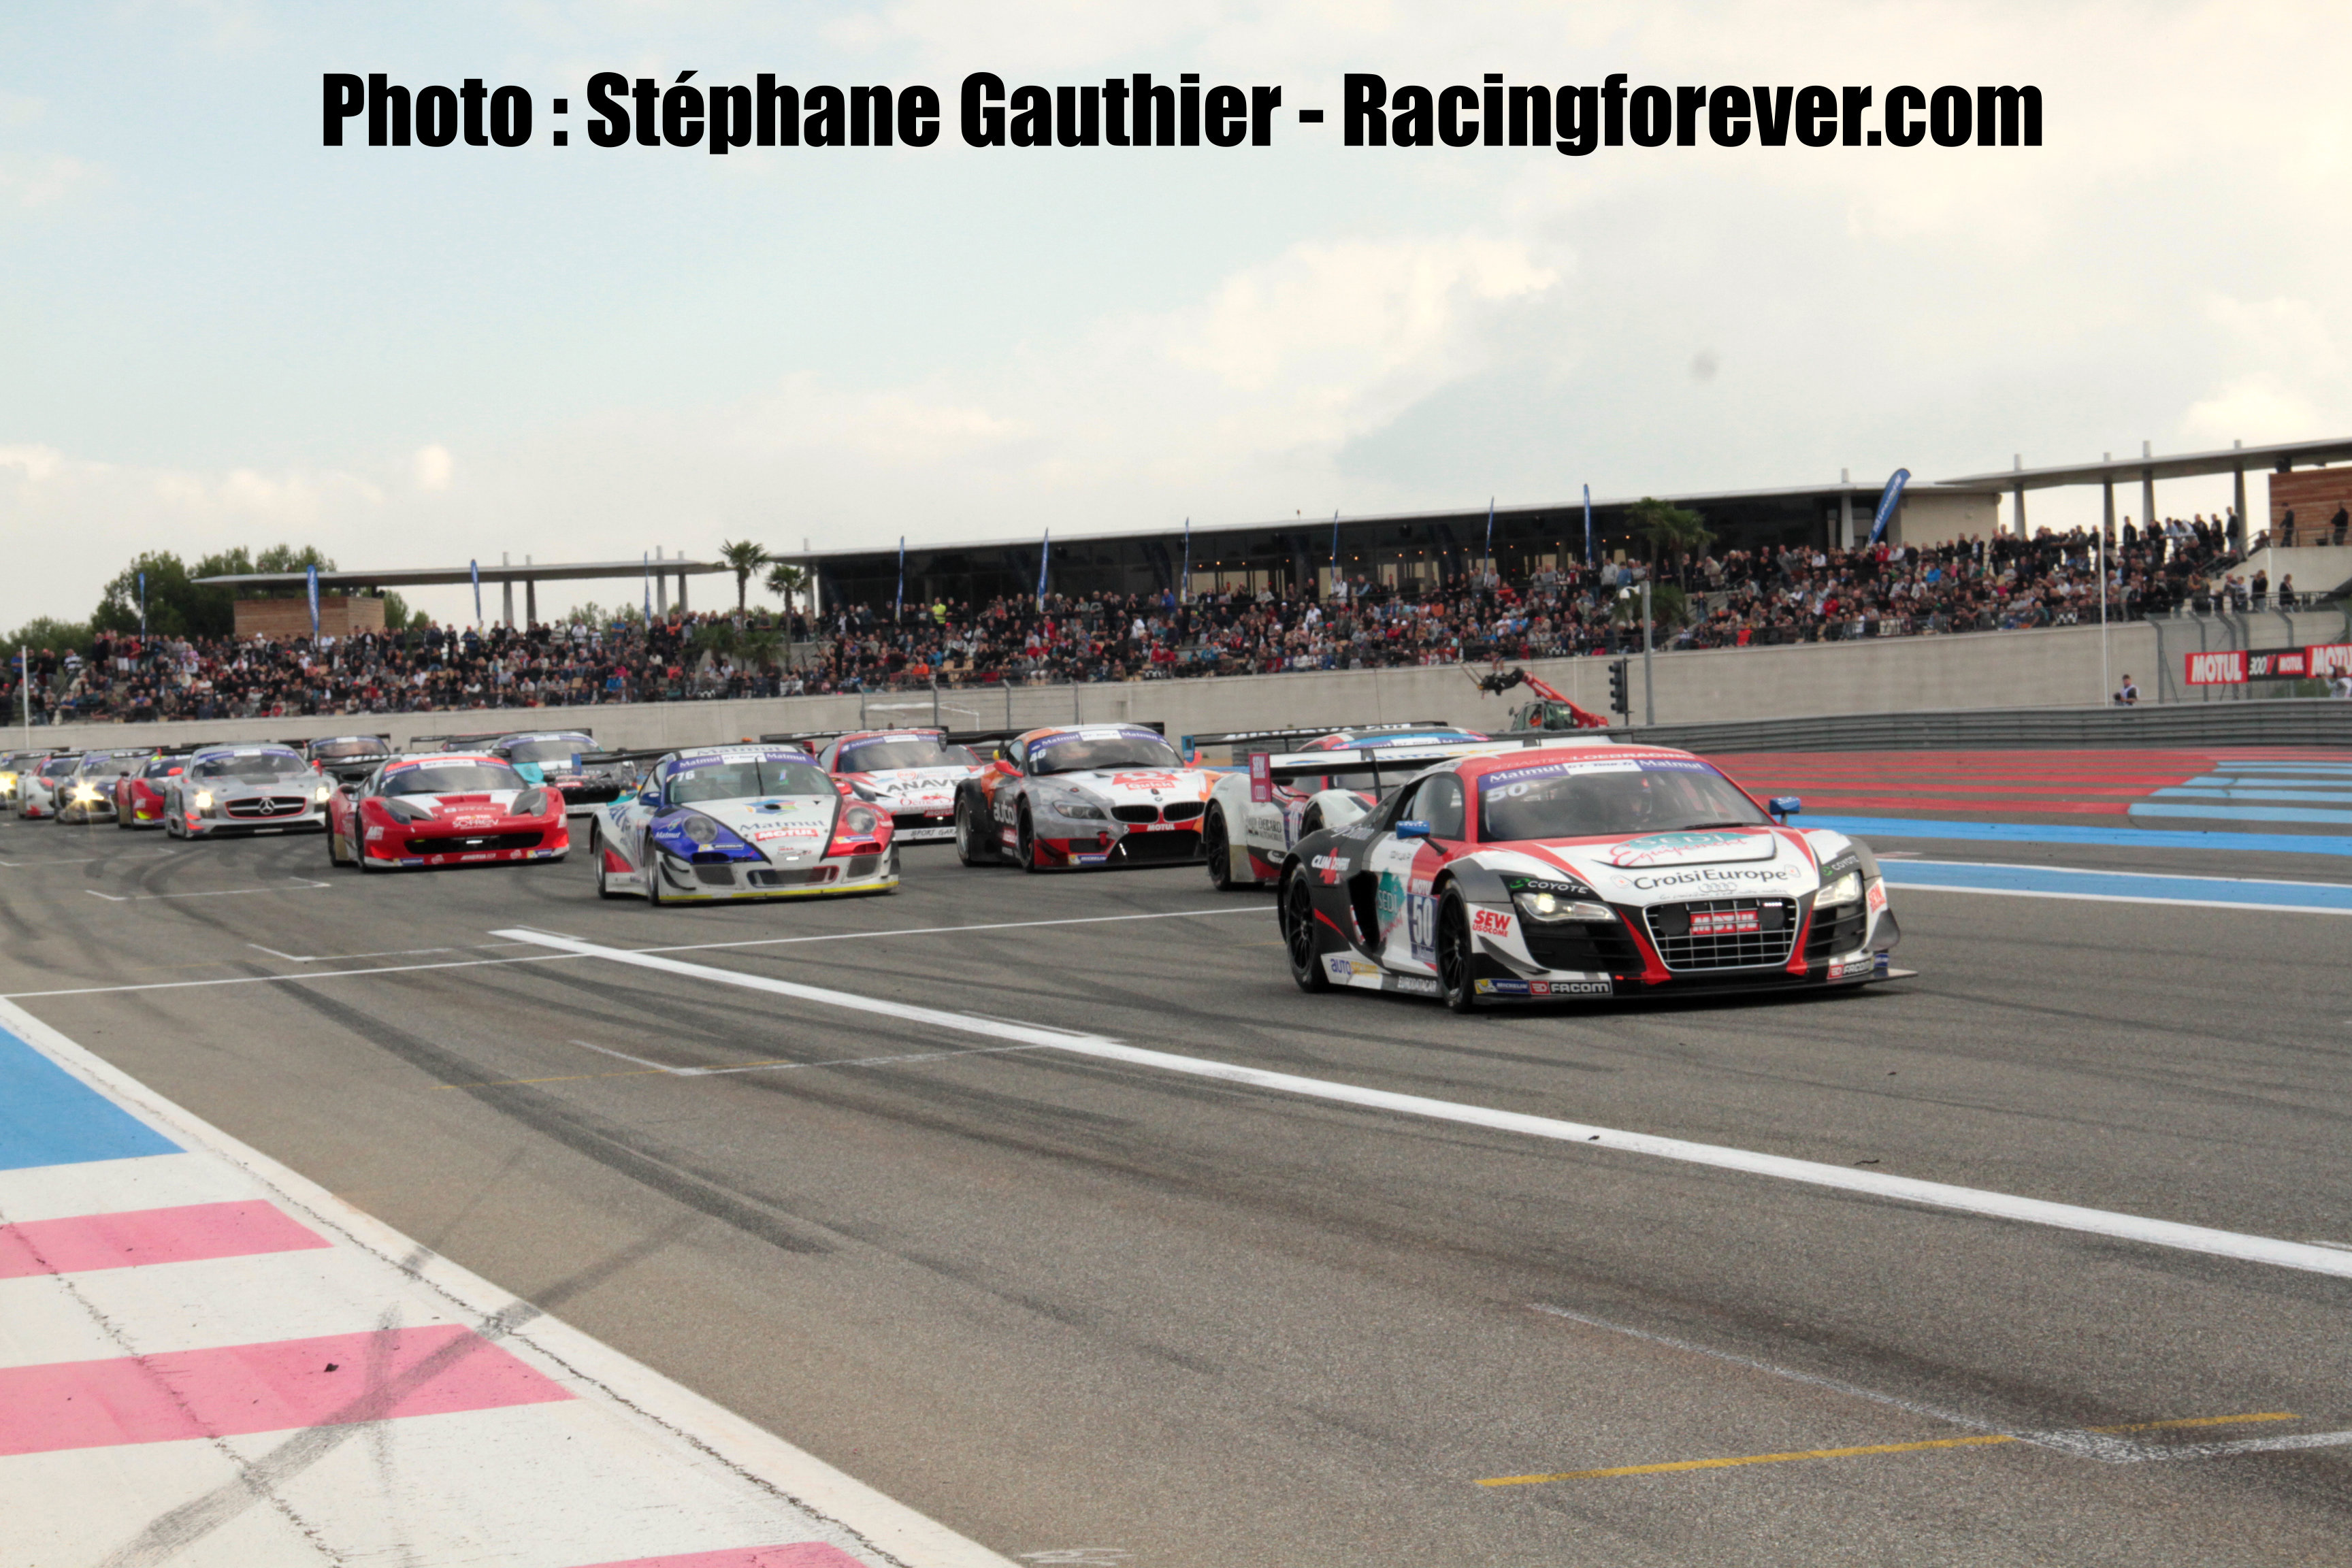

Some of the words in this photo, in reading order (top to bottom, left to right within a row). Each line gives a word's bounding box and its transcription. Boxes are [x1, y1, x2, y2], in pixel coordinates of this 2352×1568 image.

[2191, 653, 2242, 683] MOTUL
[2249, 655, 2276, 675] 300V
[2279, 656, 2304, 672] MOTUL
[1041, 734, 1080, 747] Matmut
[1122, 732, 1158, 740] Matmut
[697, 747, 781, 755] Matmut
[1029, 749, 1047, 763] 46
[680, 756, 721, 768] Matmut
[766, 753, 806, 762] Matmut
[1489, 764, 1563, 783] Matmut
[1639, 758, 1705, 771] Matmut
[1486, 783, 1530, 803] 50
[740, 819, 826, 832] Matmut
[758, 828, 817, 839] MOTUL
[1831, 855, 1860, 871] COYOTE
[1633, 868, 1788, 890] CroisiEurope
[1527, 880, 1589, 894] COYOTE
[1377, 889, 1398, 913] SEDI
[1413, 895, 1433, 947] 50
[1473, 910, 1512, 930] SEW
[1692, 913, 1757, 932] MOTUL
[1472, 924, 1509, 938] USOCOME
[1843, 960, 1872, 975] FACOM
[1550, 983, 1609, 993] FACOM
